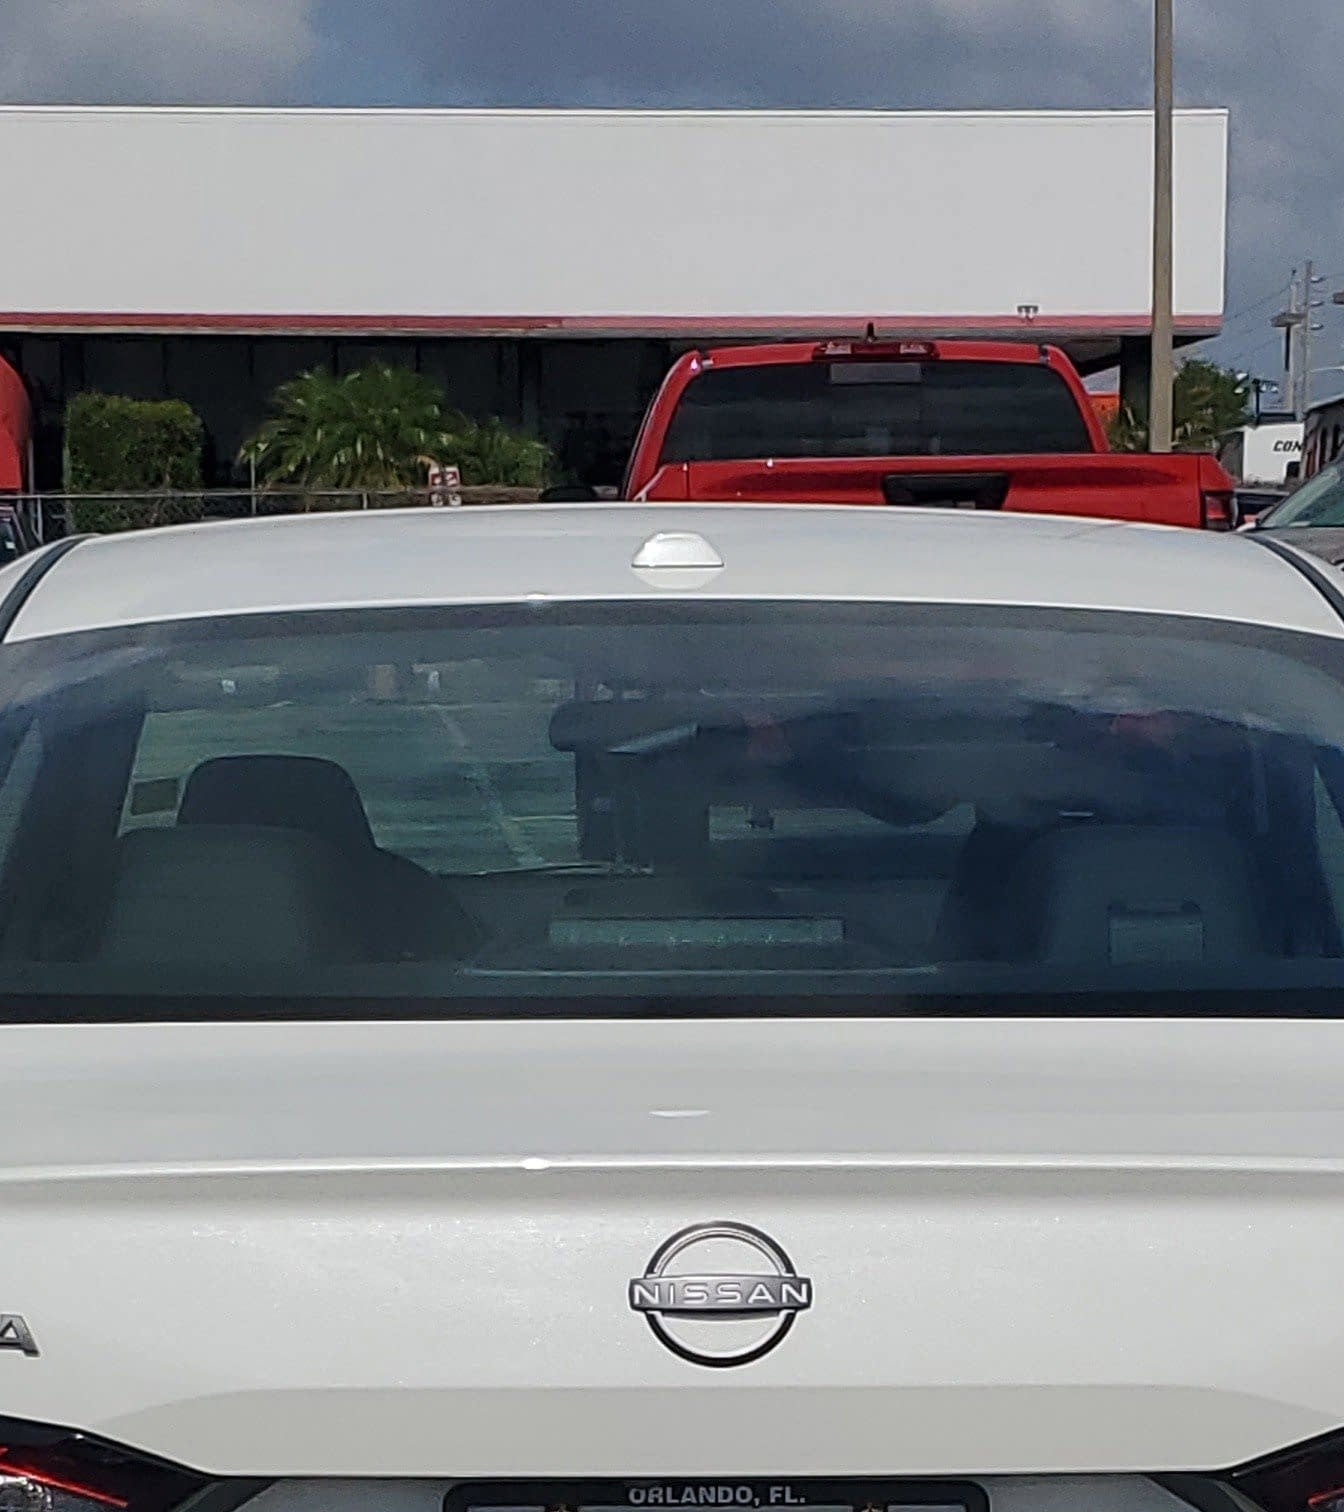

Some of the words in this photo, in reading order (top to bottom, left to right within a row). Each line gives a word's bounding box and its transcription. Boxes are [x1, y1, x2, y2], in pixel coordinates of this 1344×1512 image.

[633, 1282, 808, 1305] NISSAN
[628, 1486, 760, 1507] ORLANDO,
[769, 1485, 806, 1504] FL.
